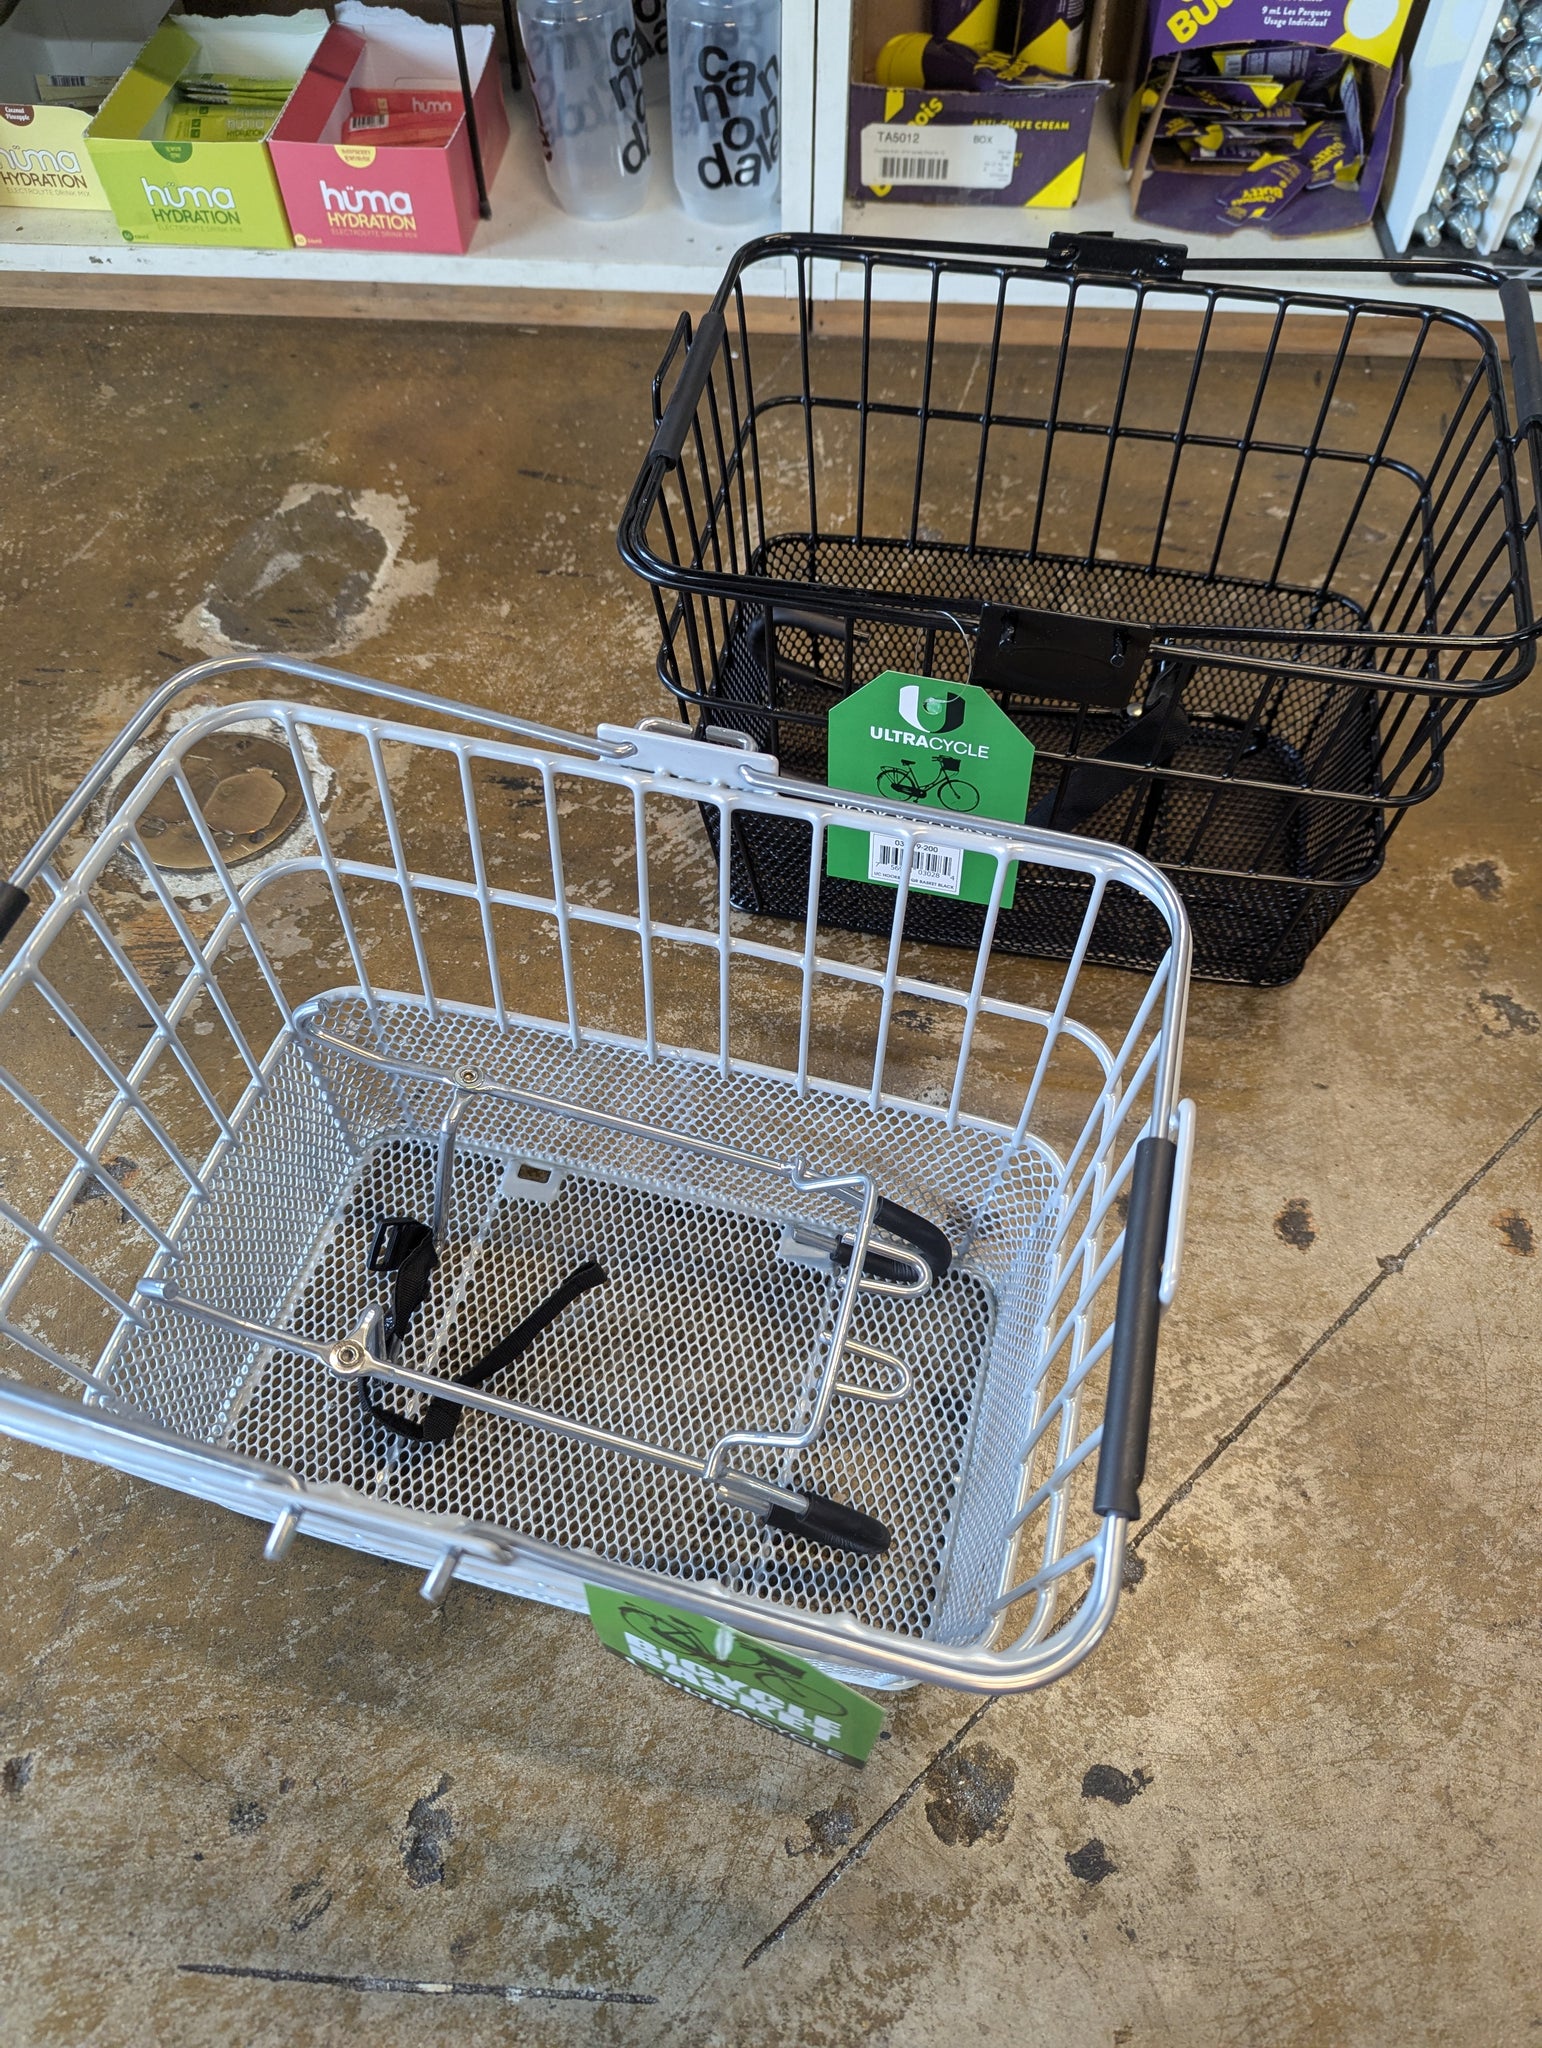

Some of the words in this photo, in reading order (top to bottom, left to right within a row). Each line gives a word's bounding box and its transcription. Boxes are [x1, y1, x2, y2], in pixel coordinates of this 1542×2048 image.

[1261, 6, 1268, 15] 9
[1269, 6, 1281, 15] mL
[1283, 7, 1296, 16] Les
[1166, 0, 1233, 44] BU
[1263, 16, 1286, 28] Usage
[1288, 17, 1328, 27] Individual
[1034, 121, 1070, 130] CREAM
[877, 131, 920, 143] TA5012
[973, 135, 993, 144] BOX
[0, 171, 87, 188] HYDRATION
[319, 180, 413, 215] hüma
[152, 208, 241, 225] HYDRATION
[327, 211, 417, 231] HYDRATION
[870, 725, 990, 760] ULTRACYCLE
[918, 870, 940, 878] 03028
[624, 1631, 842, 1735] BICYCLE
[629, 1646, 842, 1742] BASKET
[662, 1675, 845, 1761] ULTRACYCLE
